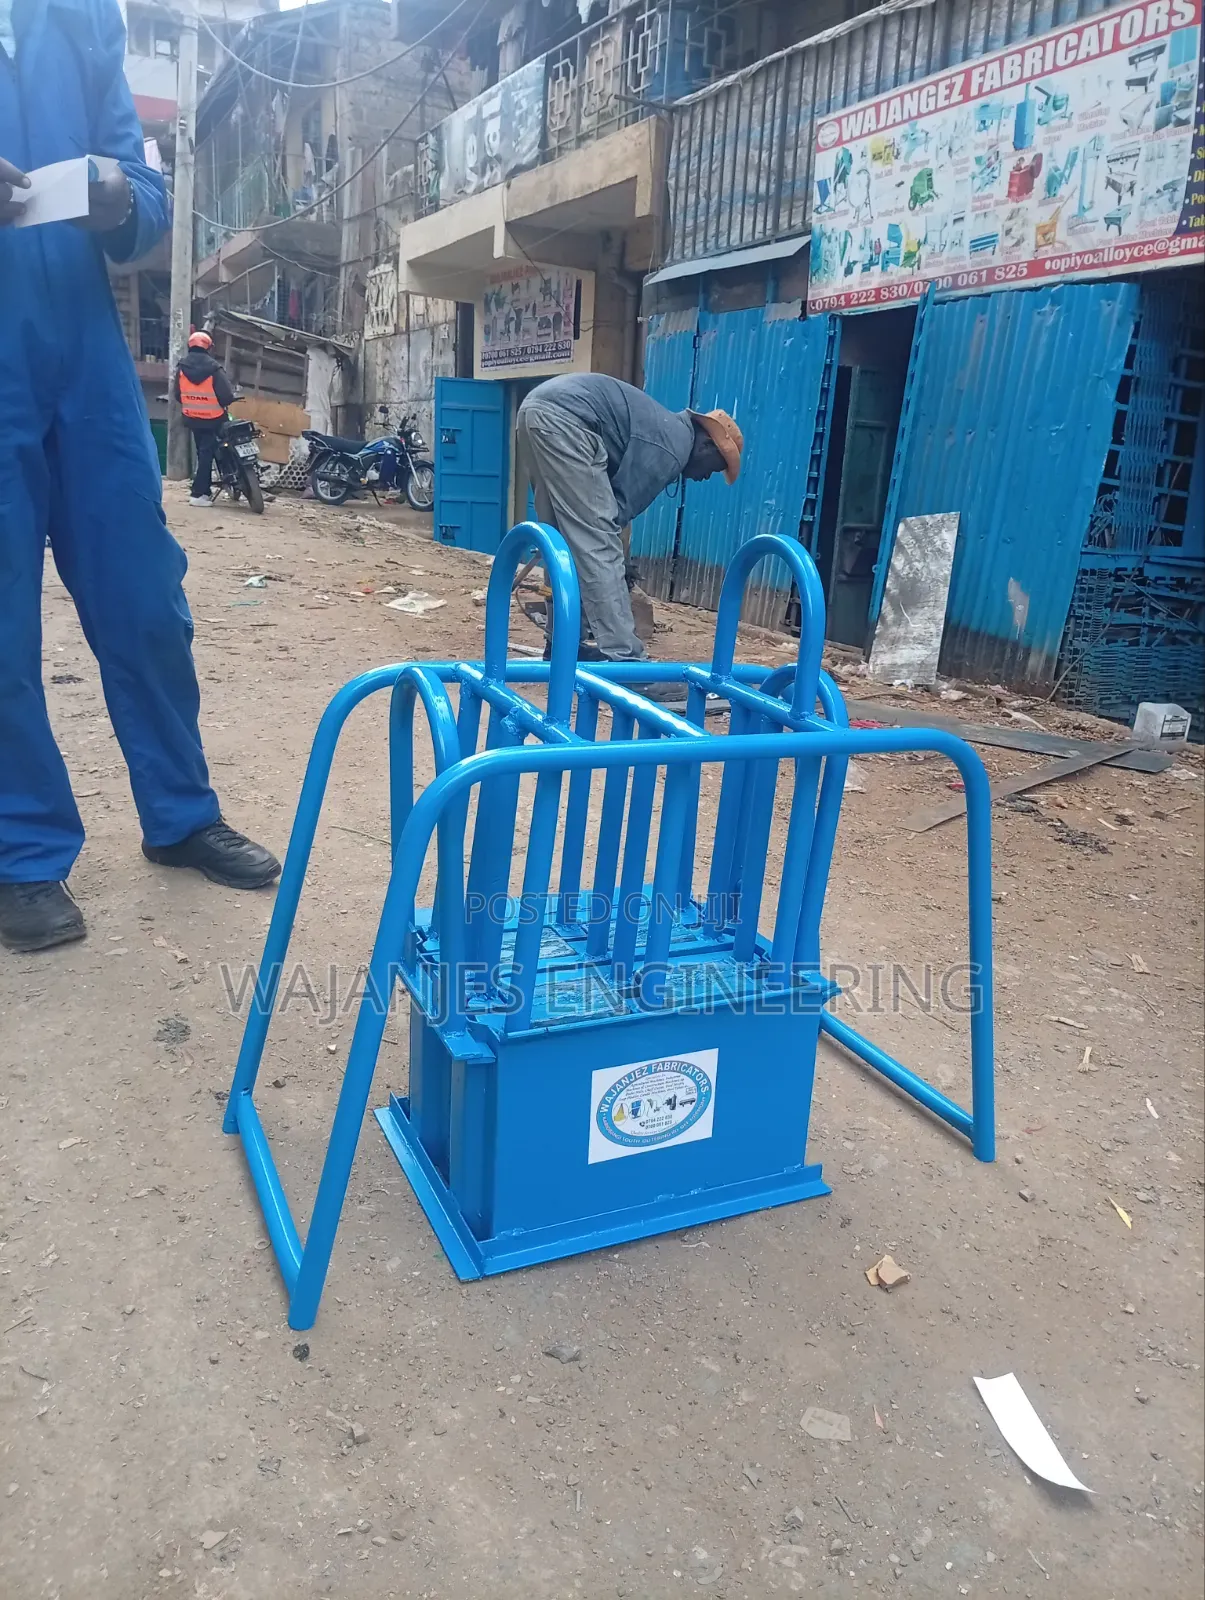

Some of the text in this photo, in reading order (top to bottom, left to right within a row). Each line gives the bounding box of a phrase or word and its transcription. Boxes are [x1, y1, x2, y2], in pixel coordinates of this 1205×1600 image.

[841, 0, 1196, 142] WAJANGEZ FABRICATORS
[815, 295, 846, 311] 0794
[850, 289, 876, 302] 222
[957, 270, 987, 286] 061
[994, 263, 1028, 281] 825
[599, 1065, 650, 1113] WAJANJEZ
[651, 1060, 709, 1094] FABRICATORS
